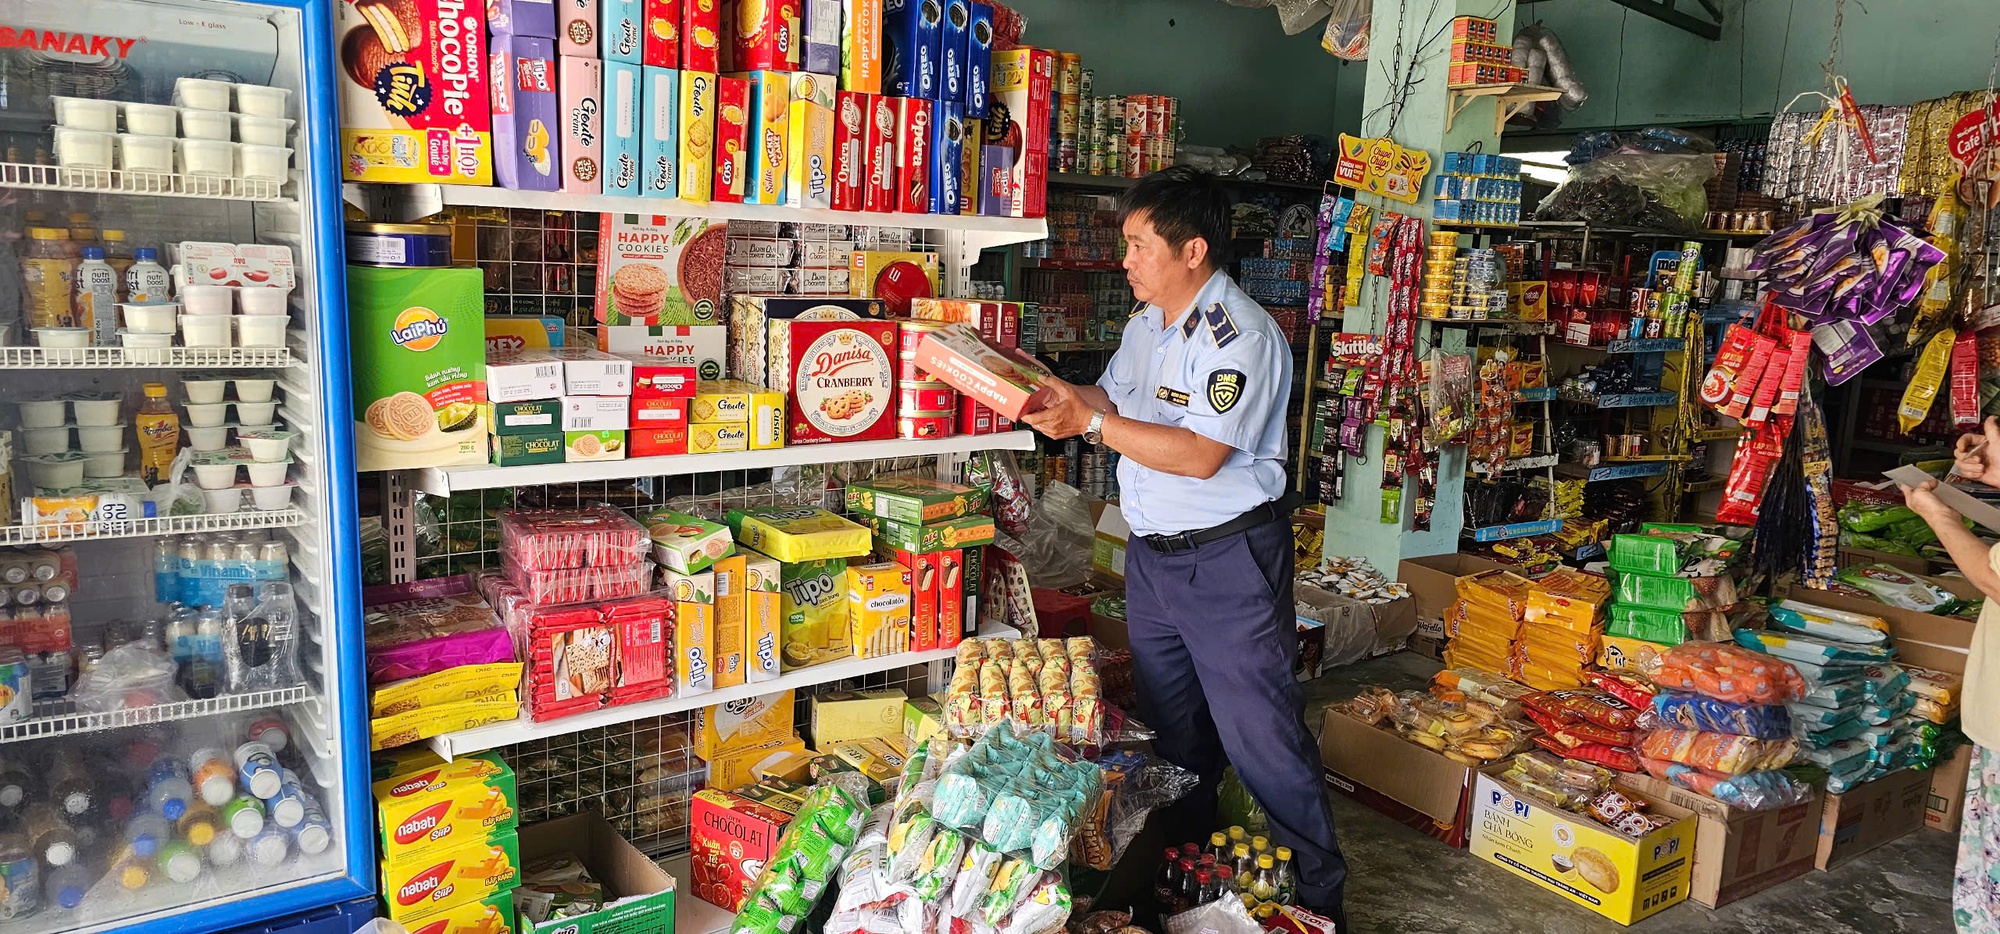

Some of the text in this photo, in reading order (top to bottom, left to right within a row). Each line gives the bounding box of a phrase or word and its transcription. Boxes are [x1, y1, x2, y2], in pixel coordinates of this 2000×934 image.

[178, 18, 227, 30] Low E glass
[571, 23, 581, 43] KEM
[578, 21, 588, 43] 35%
[0, 26, 136, 58] SANAKY
[432, 40, 440, 73] ChocoPie
[465, 33, 479, 79] ORION
[861, 37, 870, 78] HAPPY
[533, 56, 549, 91] Tipo
[920, 45, 931, 90] OREO
[947, 48, 957, 94] OREO
[973, 65, 983, 109] OREO
[581, 97, 597, 147] Gouté
[765, 128, 780, 167] MICKEY
[773, 135, 784, 160] CAKE
[912, 109, 928, 167] Opéra
[1957, 131, 1980, 154] Café
[837, 142, 850, 183] Opéra
[1370, 155, 1389, 168] Chups
[1374, 146, 1392, 158] Chupa
[576, 160, 585, 180] KEM
[582, 159, 593, 181] 35%
[810, 154, 827, 198] Tipo
[870, 146, 883, 185] Opéra
[1339, 166, 1353, 178] VUI
[944, 162, 955, 205] OREO
[1012, 199, 1021, 211] 10
[618, 233, 669, 244] HAPPY
[618, 244, 669, 253] COOKIES
[146, 273, 164, 281] nutri
[888, 267, 901, 282] LU
[486, 338, 521, 351] KEY
[644, 345, 695, 356] HAPPY
[903, 336, 912, 346] LU
[1332, 340, 1384, 357] Skittles
[811, 345, 873, 376] Danisa
[427, 379, 440, 388] kem
[817, 377, 874, 388] CRANBERRY
[930, 356, 1008, 405] HAPPY COOKIES
[1217, 374, 1238, 384] DMS
[514, 405, 543, 413] CHOCOLAT
[937, 395, 946, 405] LU
[773, 407, 782, 442] Custas
[525, 439, 559, 448] CHOCOLAT
[199, 564, 256, 578] Vinamilk
[785, 573, 834, 607] Tipo
[757, 633, 775, 670] Tipo
[689, 647, 708, 687] Tipo
[393, 778, 430, 794] nabati
[1491, 789, 1530, 818] POPI
[398, 815, 436, 837] nabati
[704, 811, 763, 847] CHOCOLAT
[1484, 809, 1510, 828] BÁNH
[1654, 837, 1680, 862] POPI
[401, 876, 438, 898] nabati
